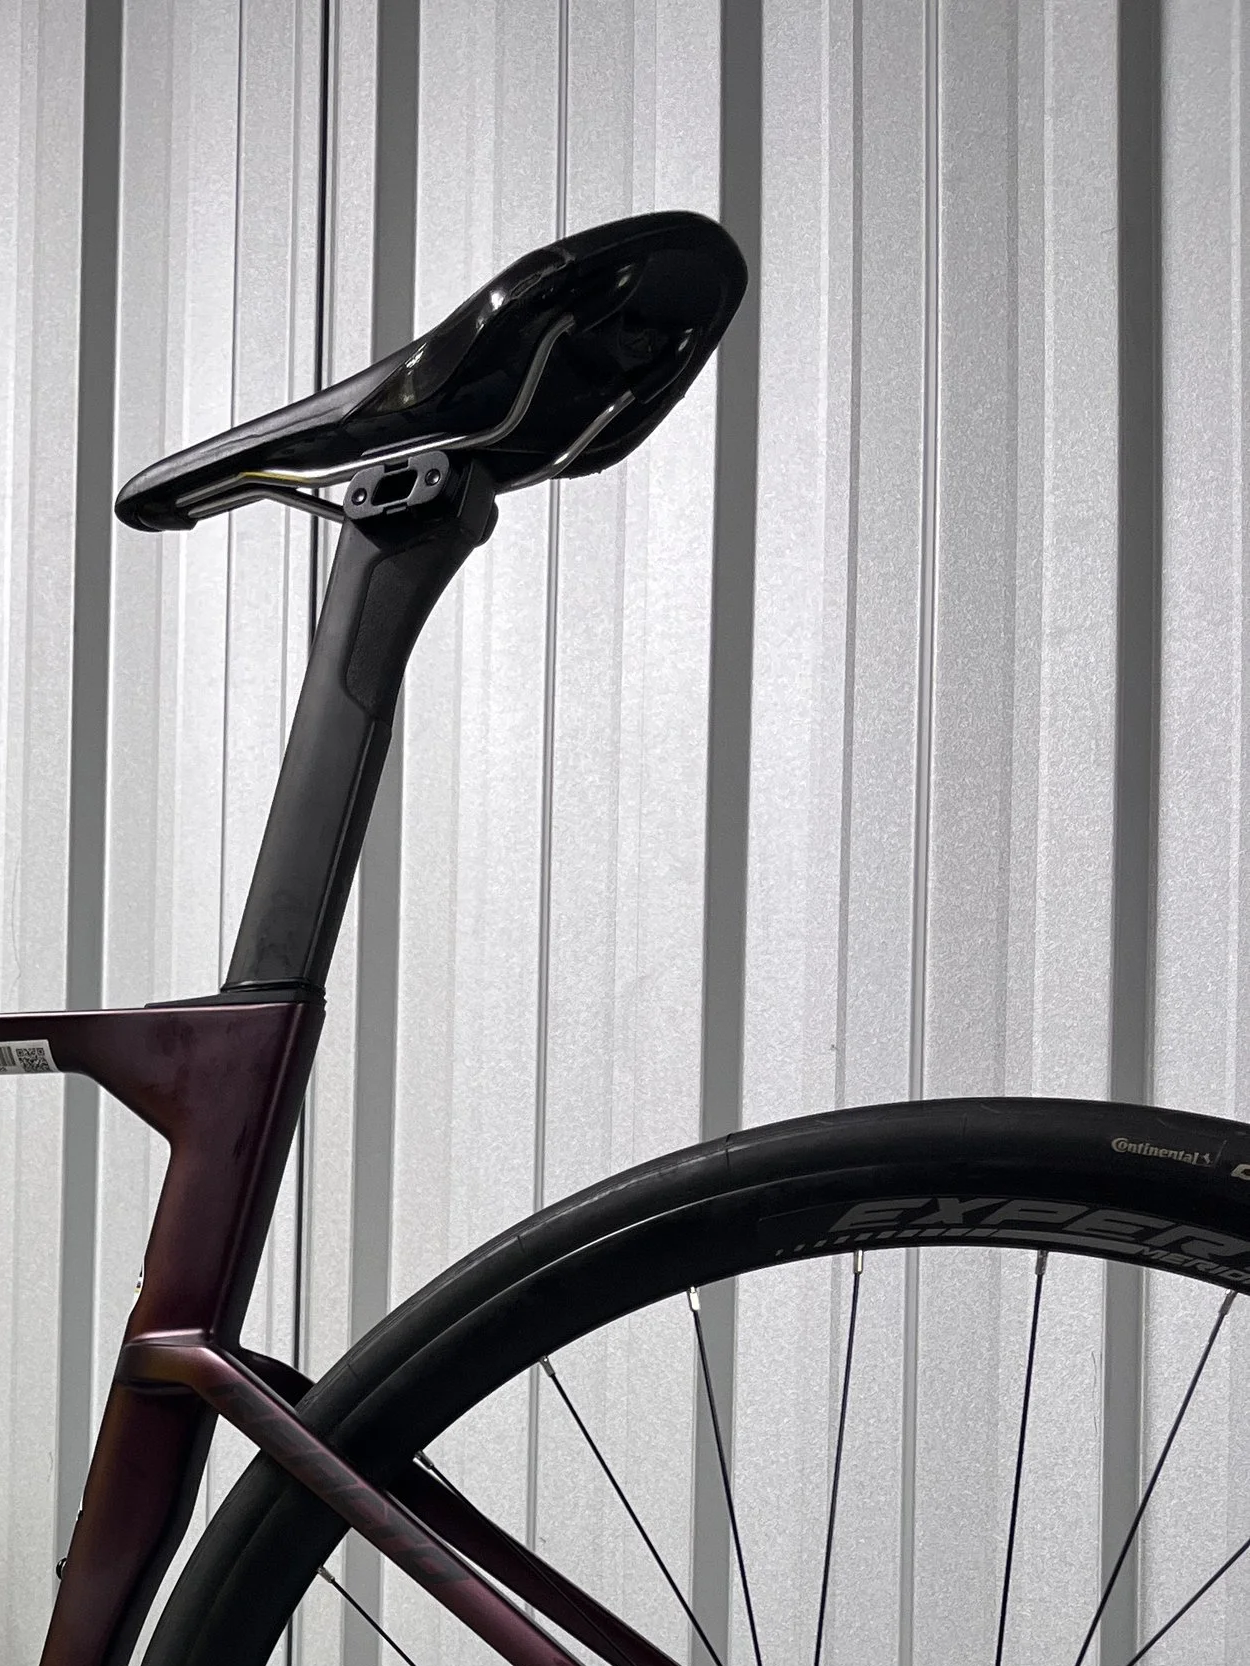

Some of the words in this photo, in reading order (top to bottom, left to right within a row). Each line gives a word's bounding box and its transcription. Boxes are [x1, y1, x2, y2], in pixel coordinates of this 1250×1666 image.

[1110, 1137, 1200, 1165] Continental
[828, 1197, 1250, 1273] EXPER
[1140, 1246, 1250, 1286] MERID
